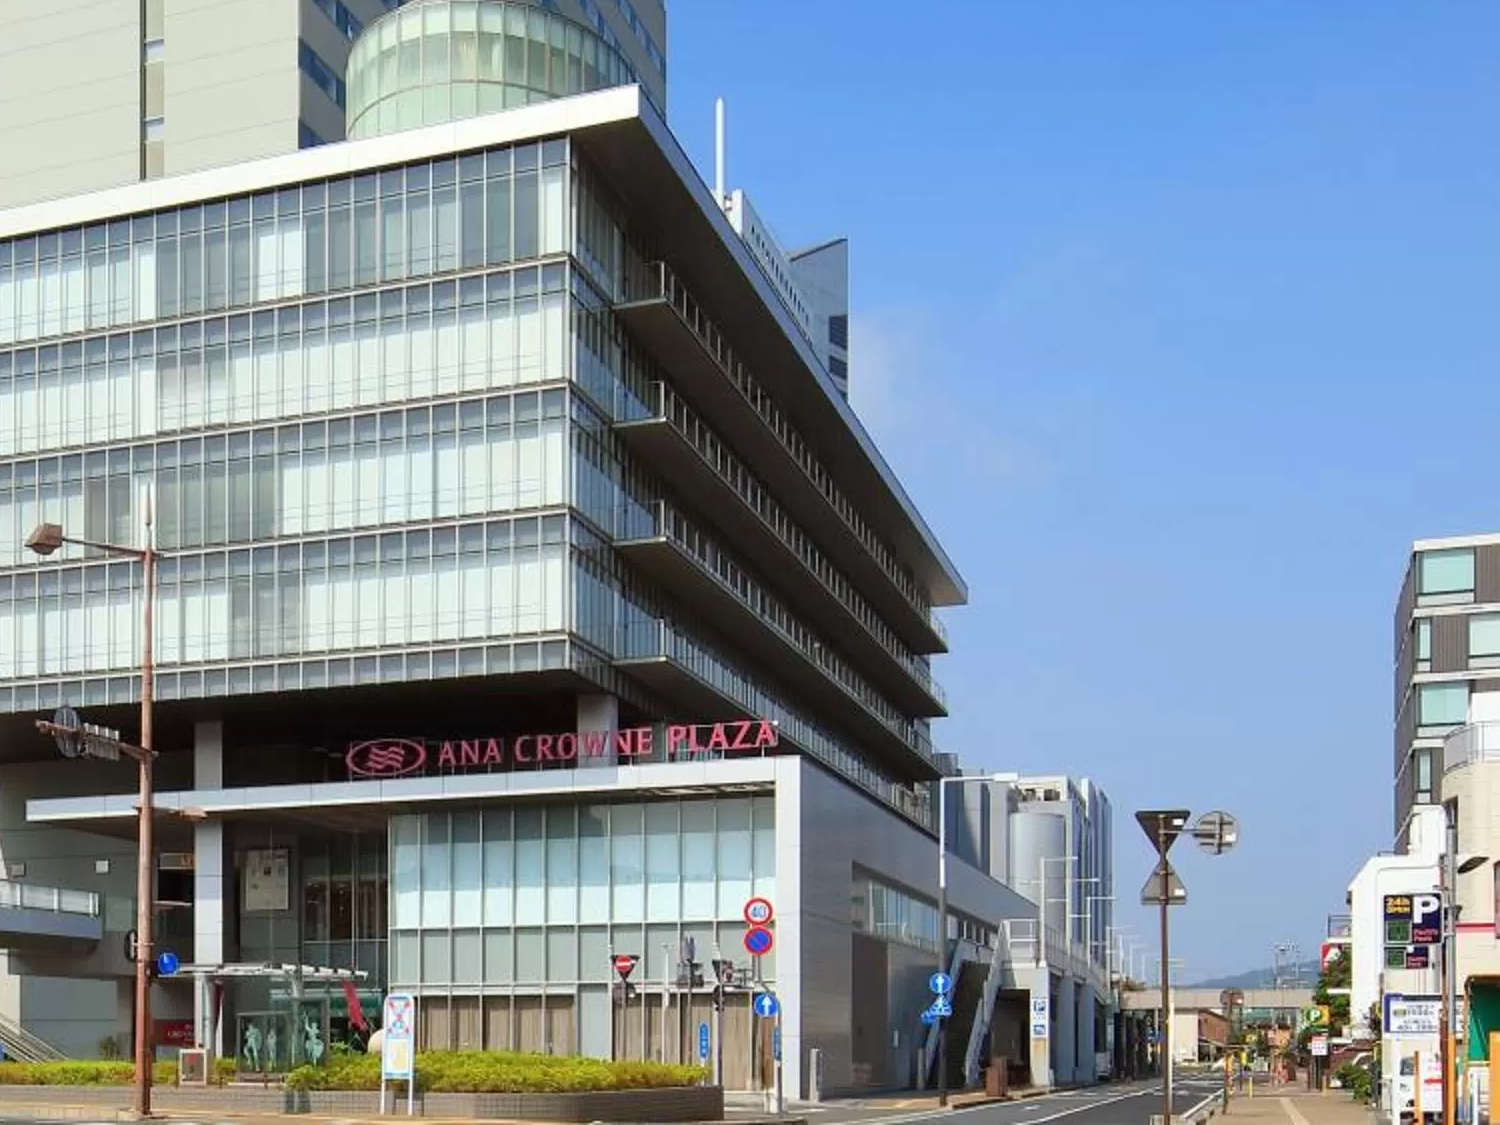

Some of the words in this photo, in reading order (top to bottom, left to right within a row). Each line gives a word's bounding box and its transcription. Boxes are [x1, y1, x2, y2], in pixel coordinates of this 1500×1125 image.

[438, 738, 501, 766] ANA
[514, 726, 652, 762] CROWNE
[667, 721, 775, 753] PLAZA
[751, 905, 767, 919] 40
[1413, 896, 1440, 924] P
